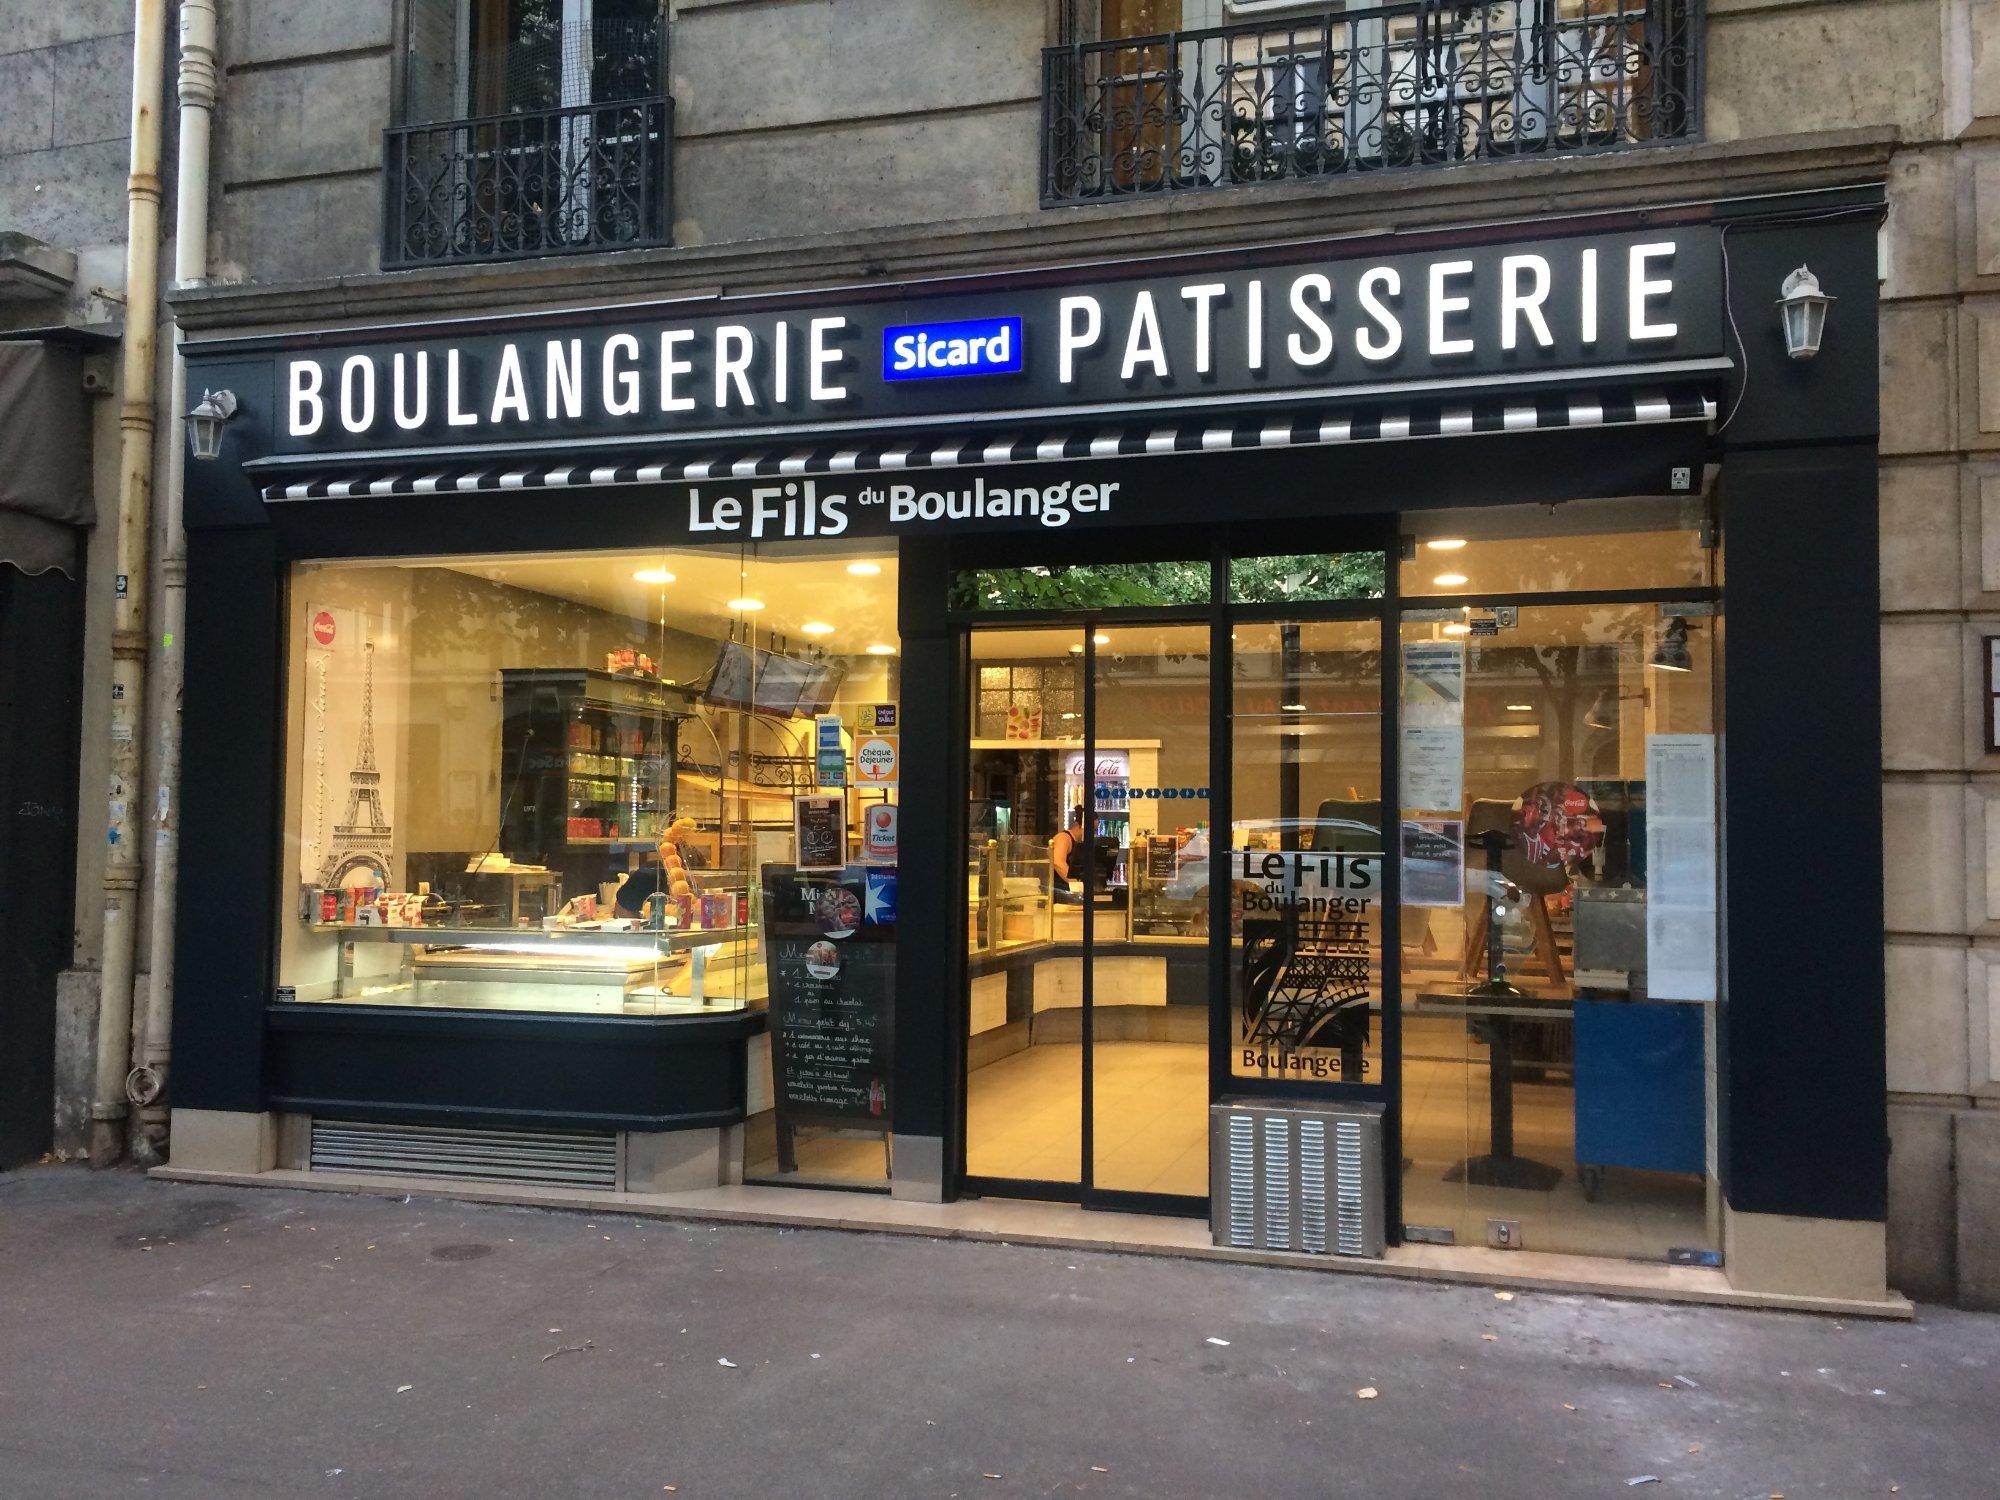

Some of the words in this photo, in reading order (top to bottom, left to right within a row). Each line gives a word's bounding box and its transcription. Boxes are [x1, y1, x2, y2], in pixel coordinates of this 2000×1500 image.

[1058, 241, 1678, 384] PATISSERIE
[893, 323, 1011, 371] Sicard
[289, 316, 848, 436] BOULANGERIE
[688, 488, 742, 531] Le
[750, 480, 848, 538] Fils
[858, 486, 885, 505] du
[889, 477, 1120, 527] Boulanger
[860, 756, 893, 765] Déjeuner
[862, 748, 891, 756] Chèque
[872, 834, 895, 842] Ticket
[1243, 846, 1285, 879] Le
[1294, 845, 1371, 889] Fils
[1264, 881, 1285, 894] du
[1242, 889, 1371, 920] Boulanger
[1243, 1050, 1370, 1077] Boulangee
